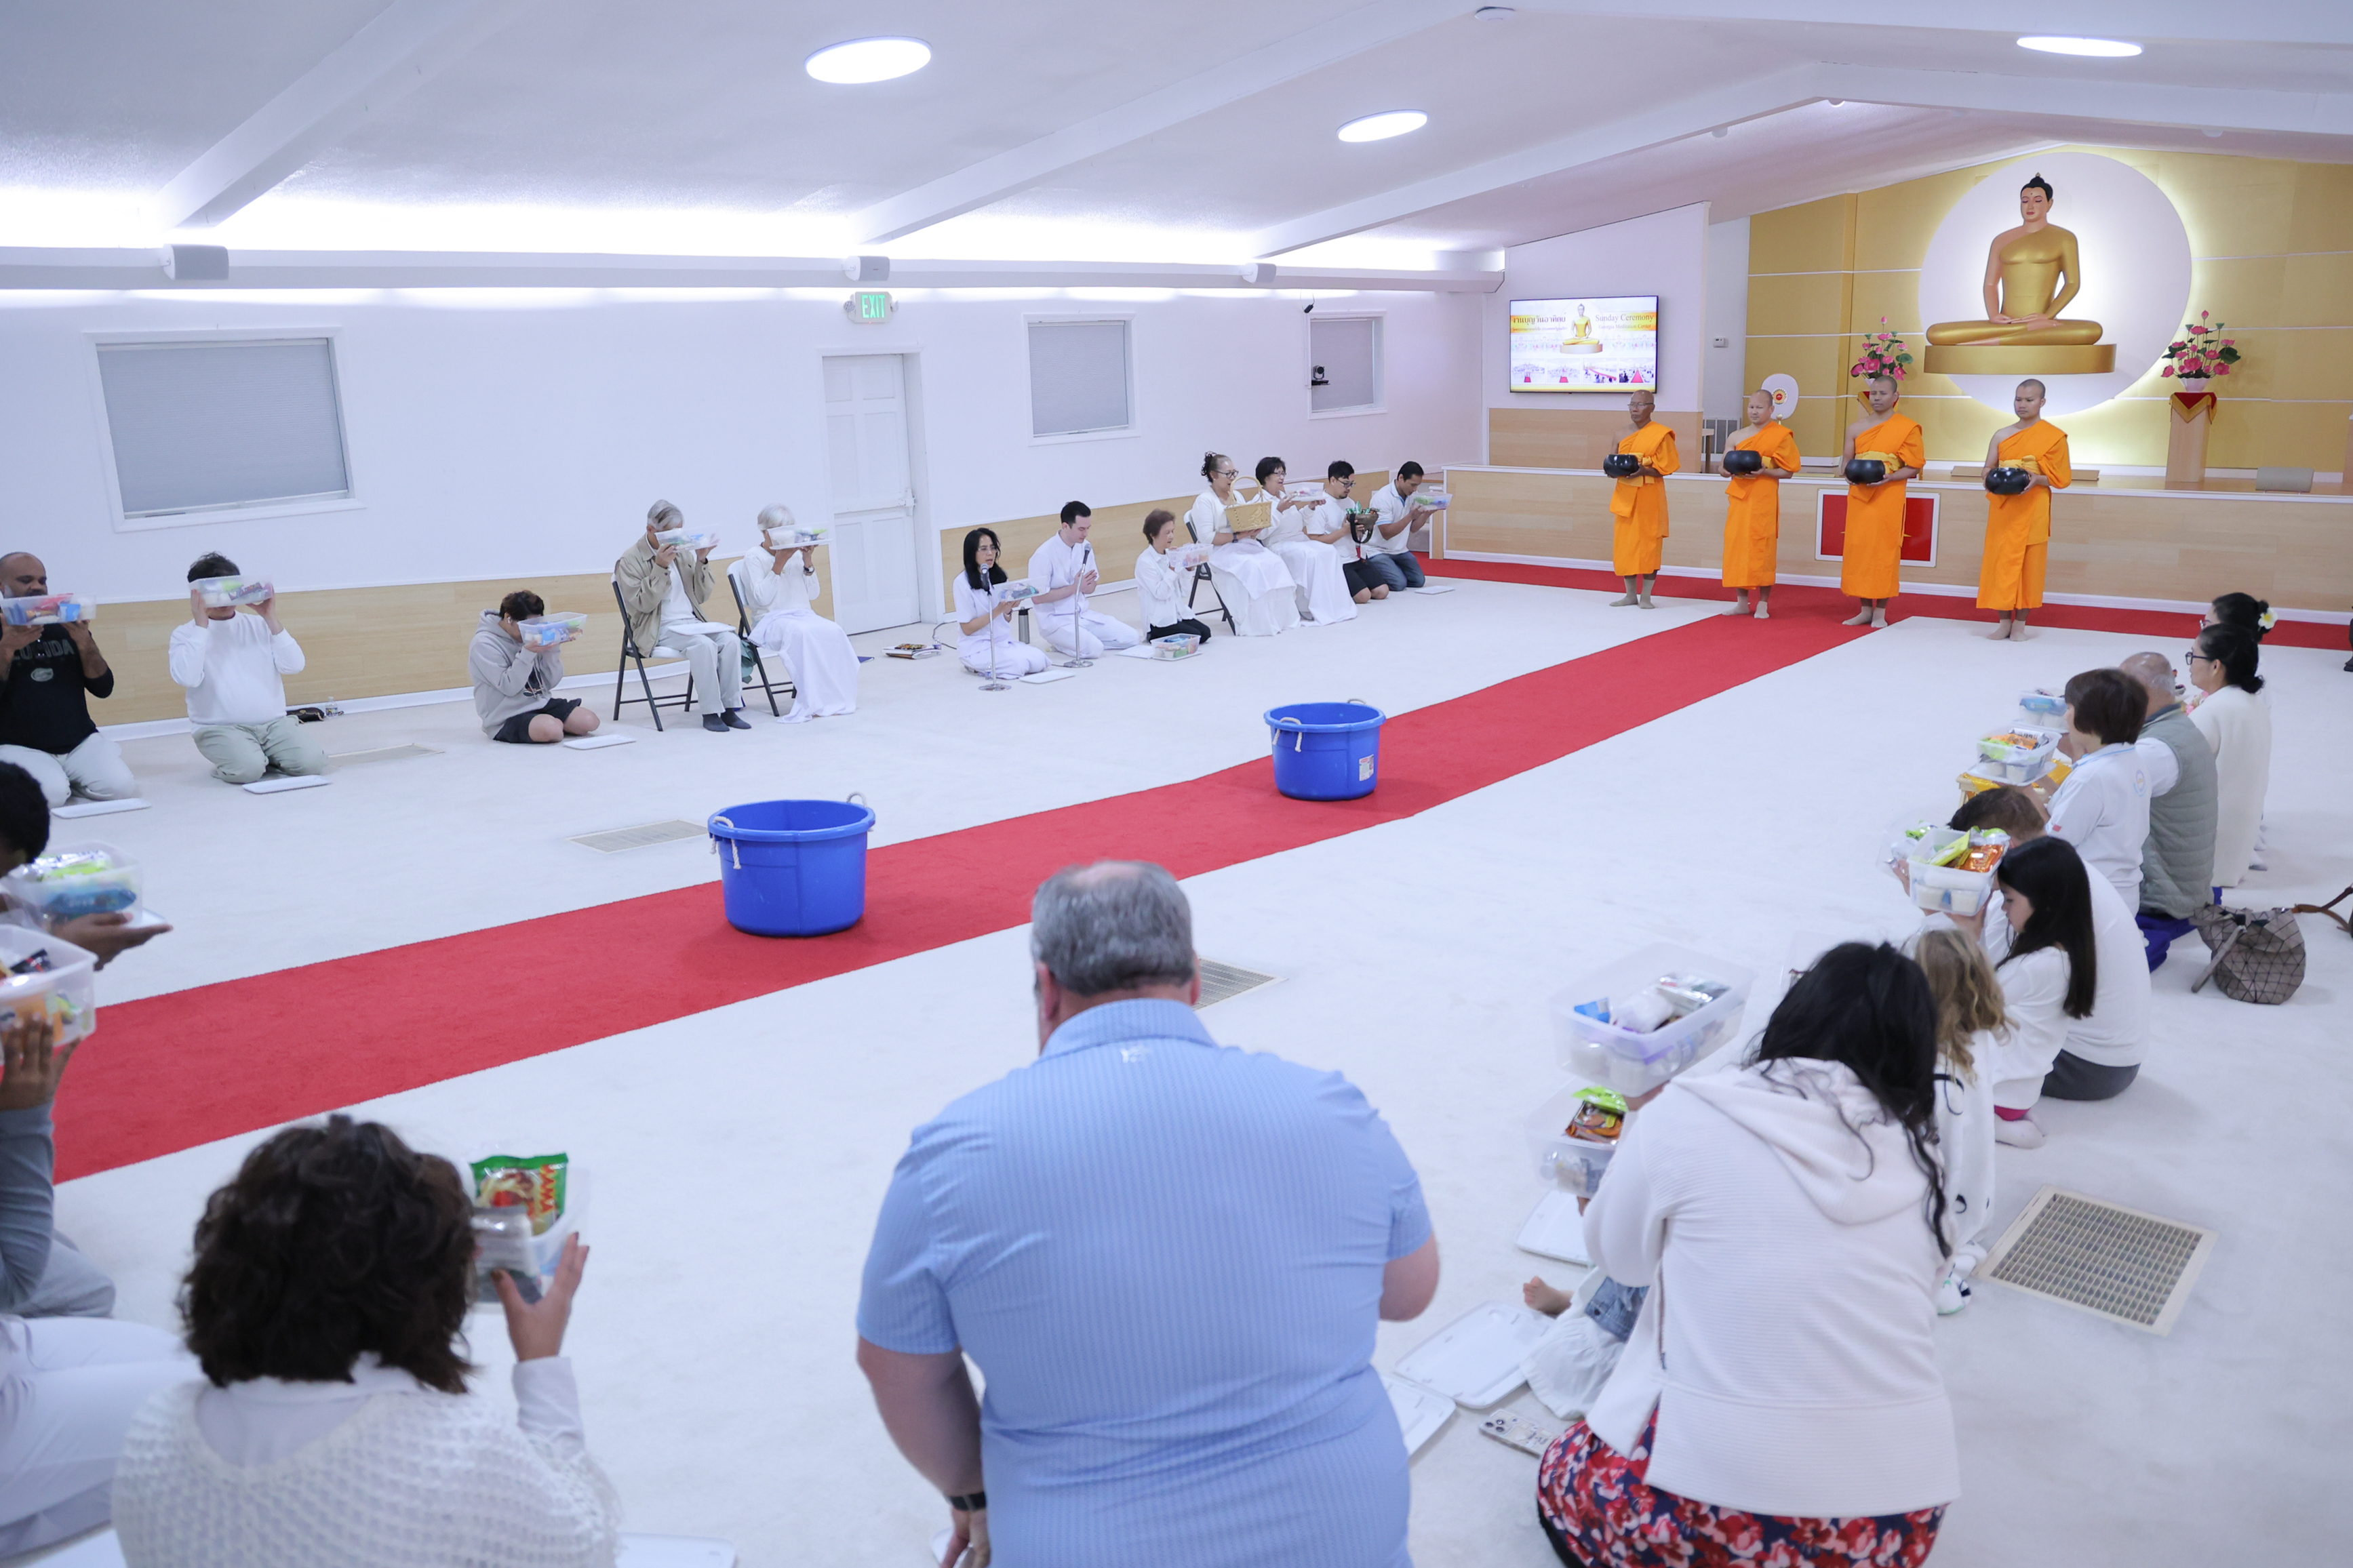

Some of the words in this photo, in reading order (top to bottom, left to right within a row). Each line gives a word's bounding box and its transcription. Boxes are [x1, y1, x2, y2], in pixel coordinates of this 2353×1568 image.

[861, 294, 886, 318] EXIT
[1595, 314, 1619, 323] Sunday
[1620, 313, 1655, 322] Ceremony
